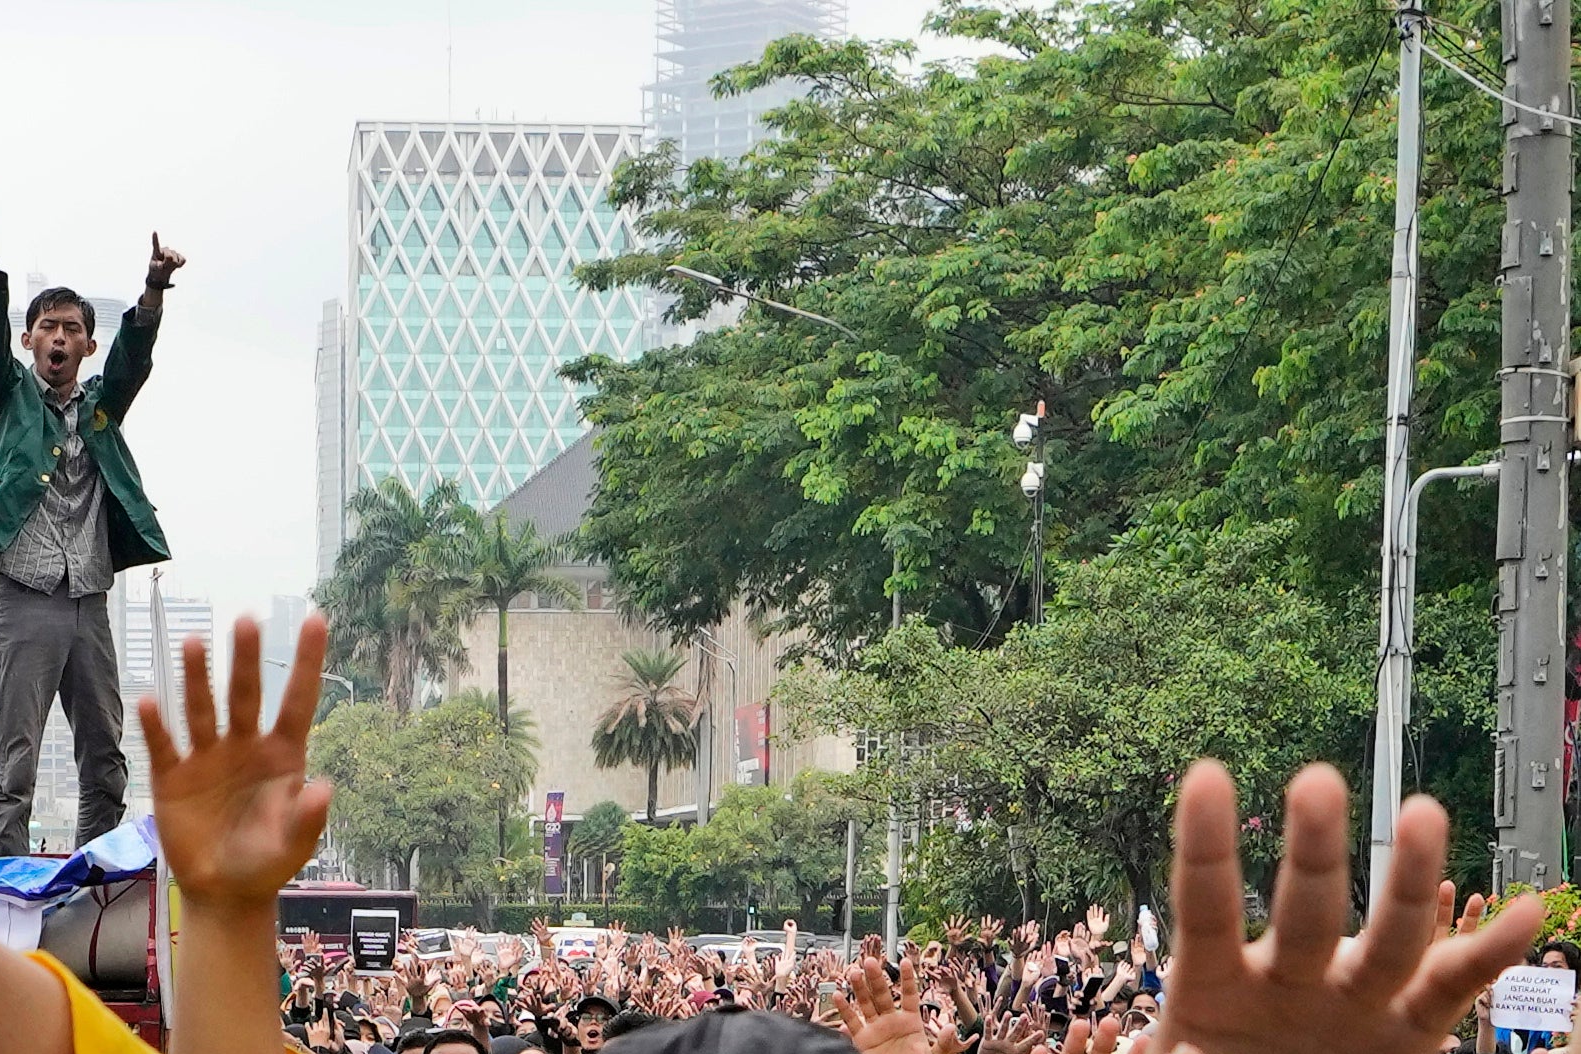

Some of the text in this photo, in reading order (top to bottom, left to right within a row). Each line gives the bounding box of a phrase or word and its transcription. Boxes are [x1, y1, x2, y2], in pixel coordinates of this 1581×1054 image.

[1504, 994, 1558, 1005] JANGAN BUAT
[1495, 1002, 1564, 1015] RAKYAT MELARAT
